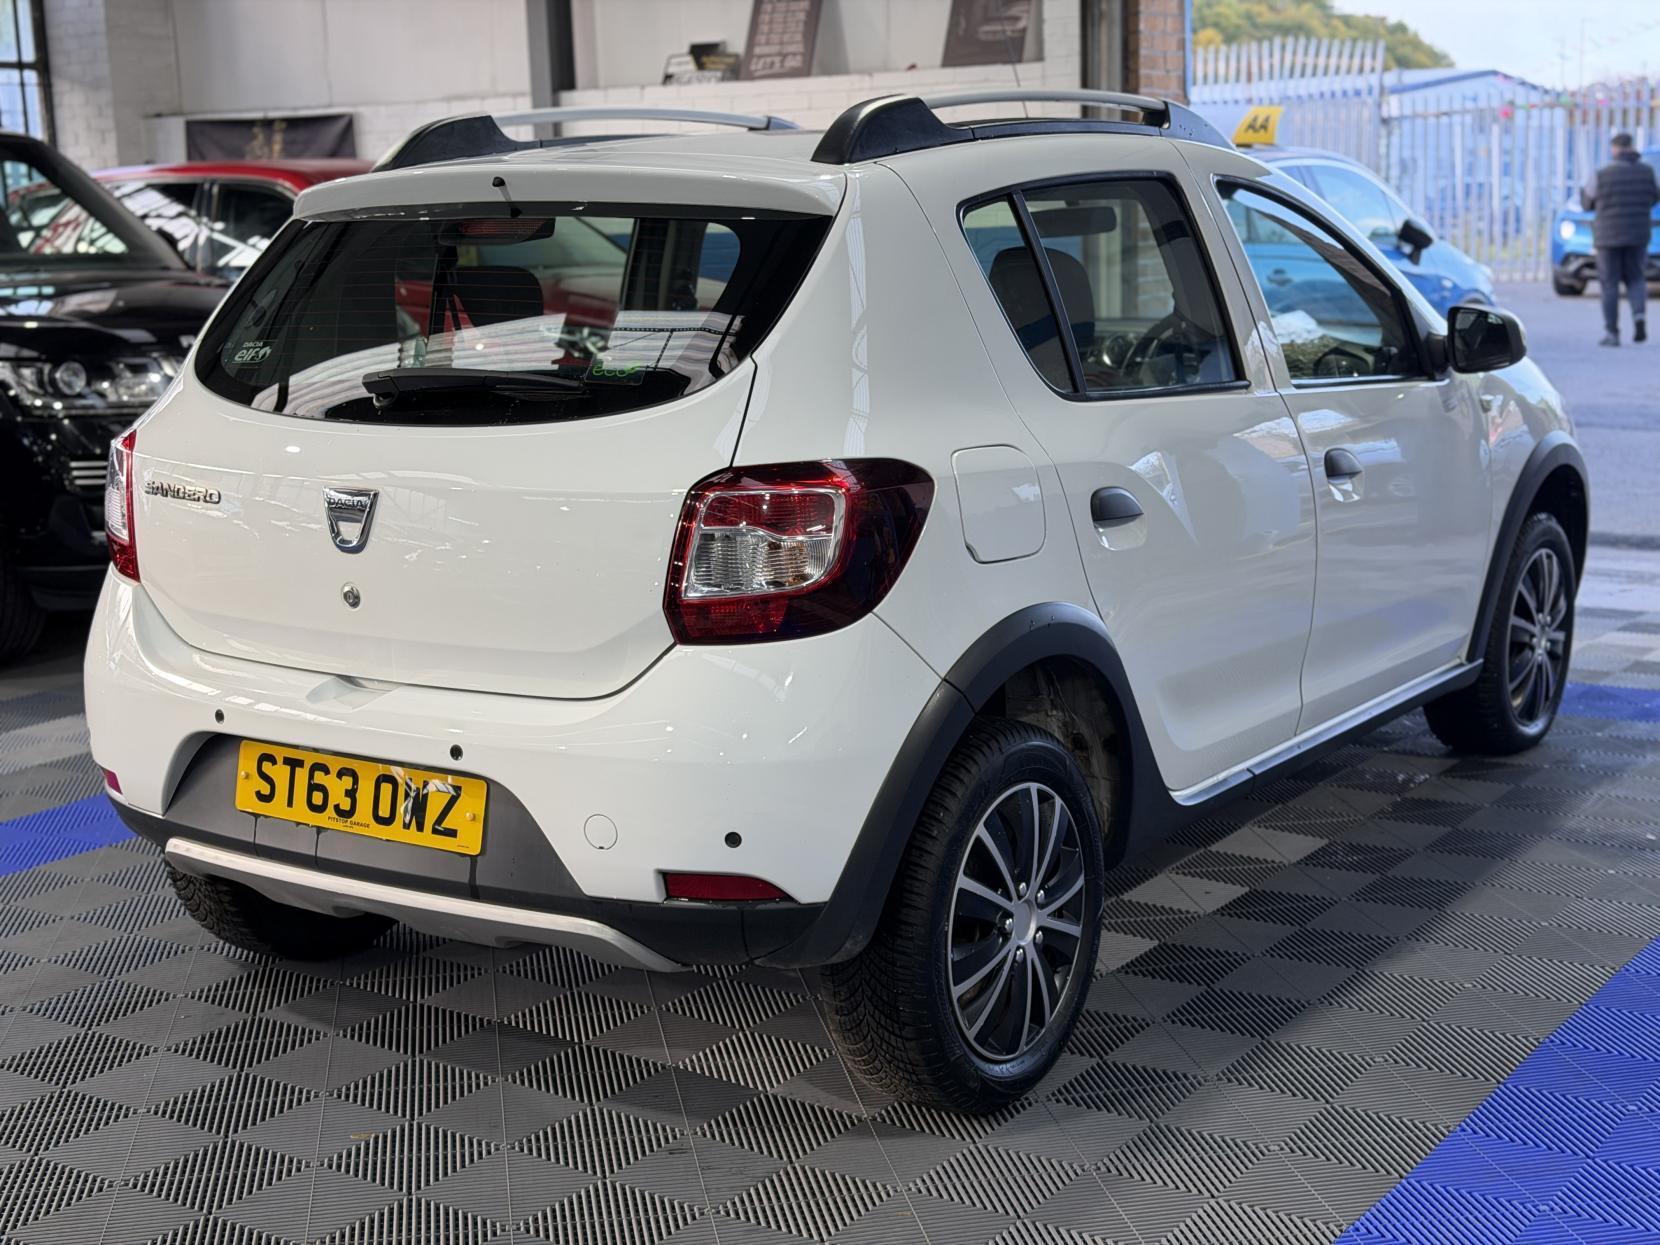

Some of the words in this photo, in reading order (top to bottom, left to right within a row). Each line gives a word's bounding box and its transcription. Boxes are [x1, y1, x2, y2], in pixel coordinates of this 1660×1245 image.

[1243, 114, 1271, 134] AA
[145, 481, 221, 504] SANDERO
[328, 497, 369, 510] DACIA
[255, 752, 360, 820] ST63
[372, 772, 463, 840] OWZ
[327, 816, 349, 825] PITSTOP
[349, 820, 371, 829] GARAGE
